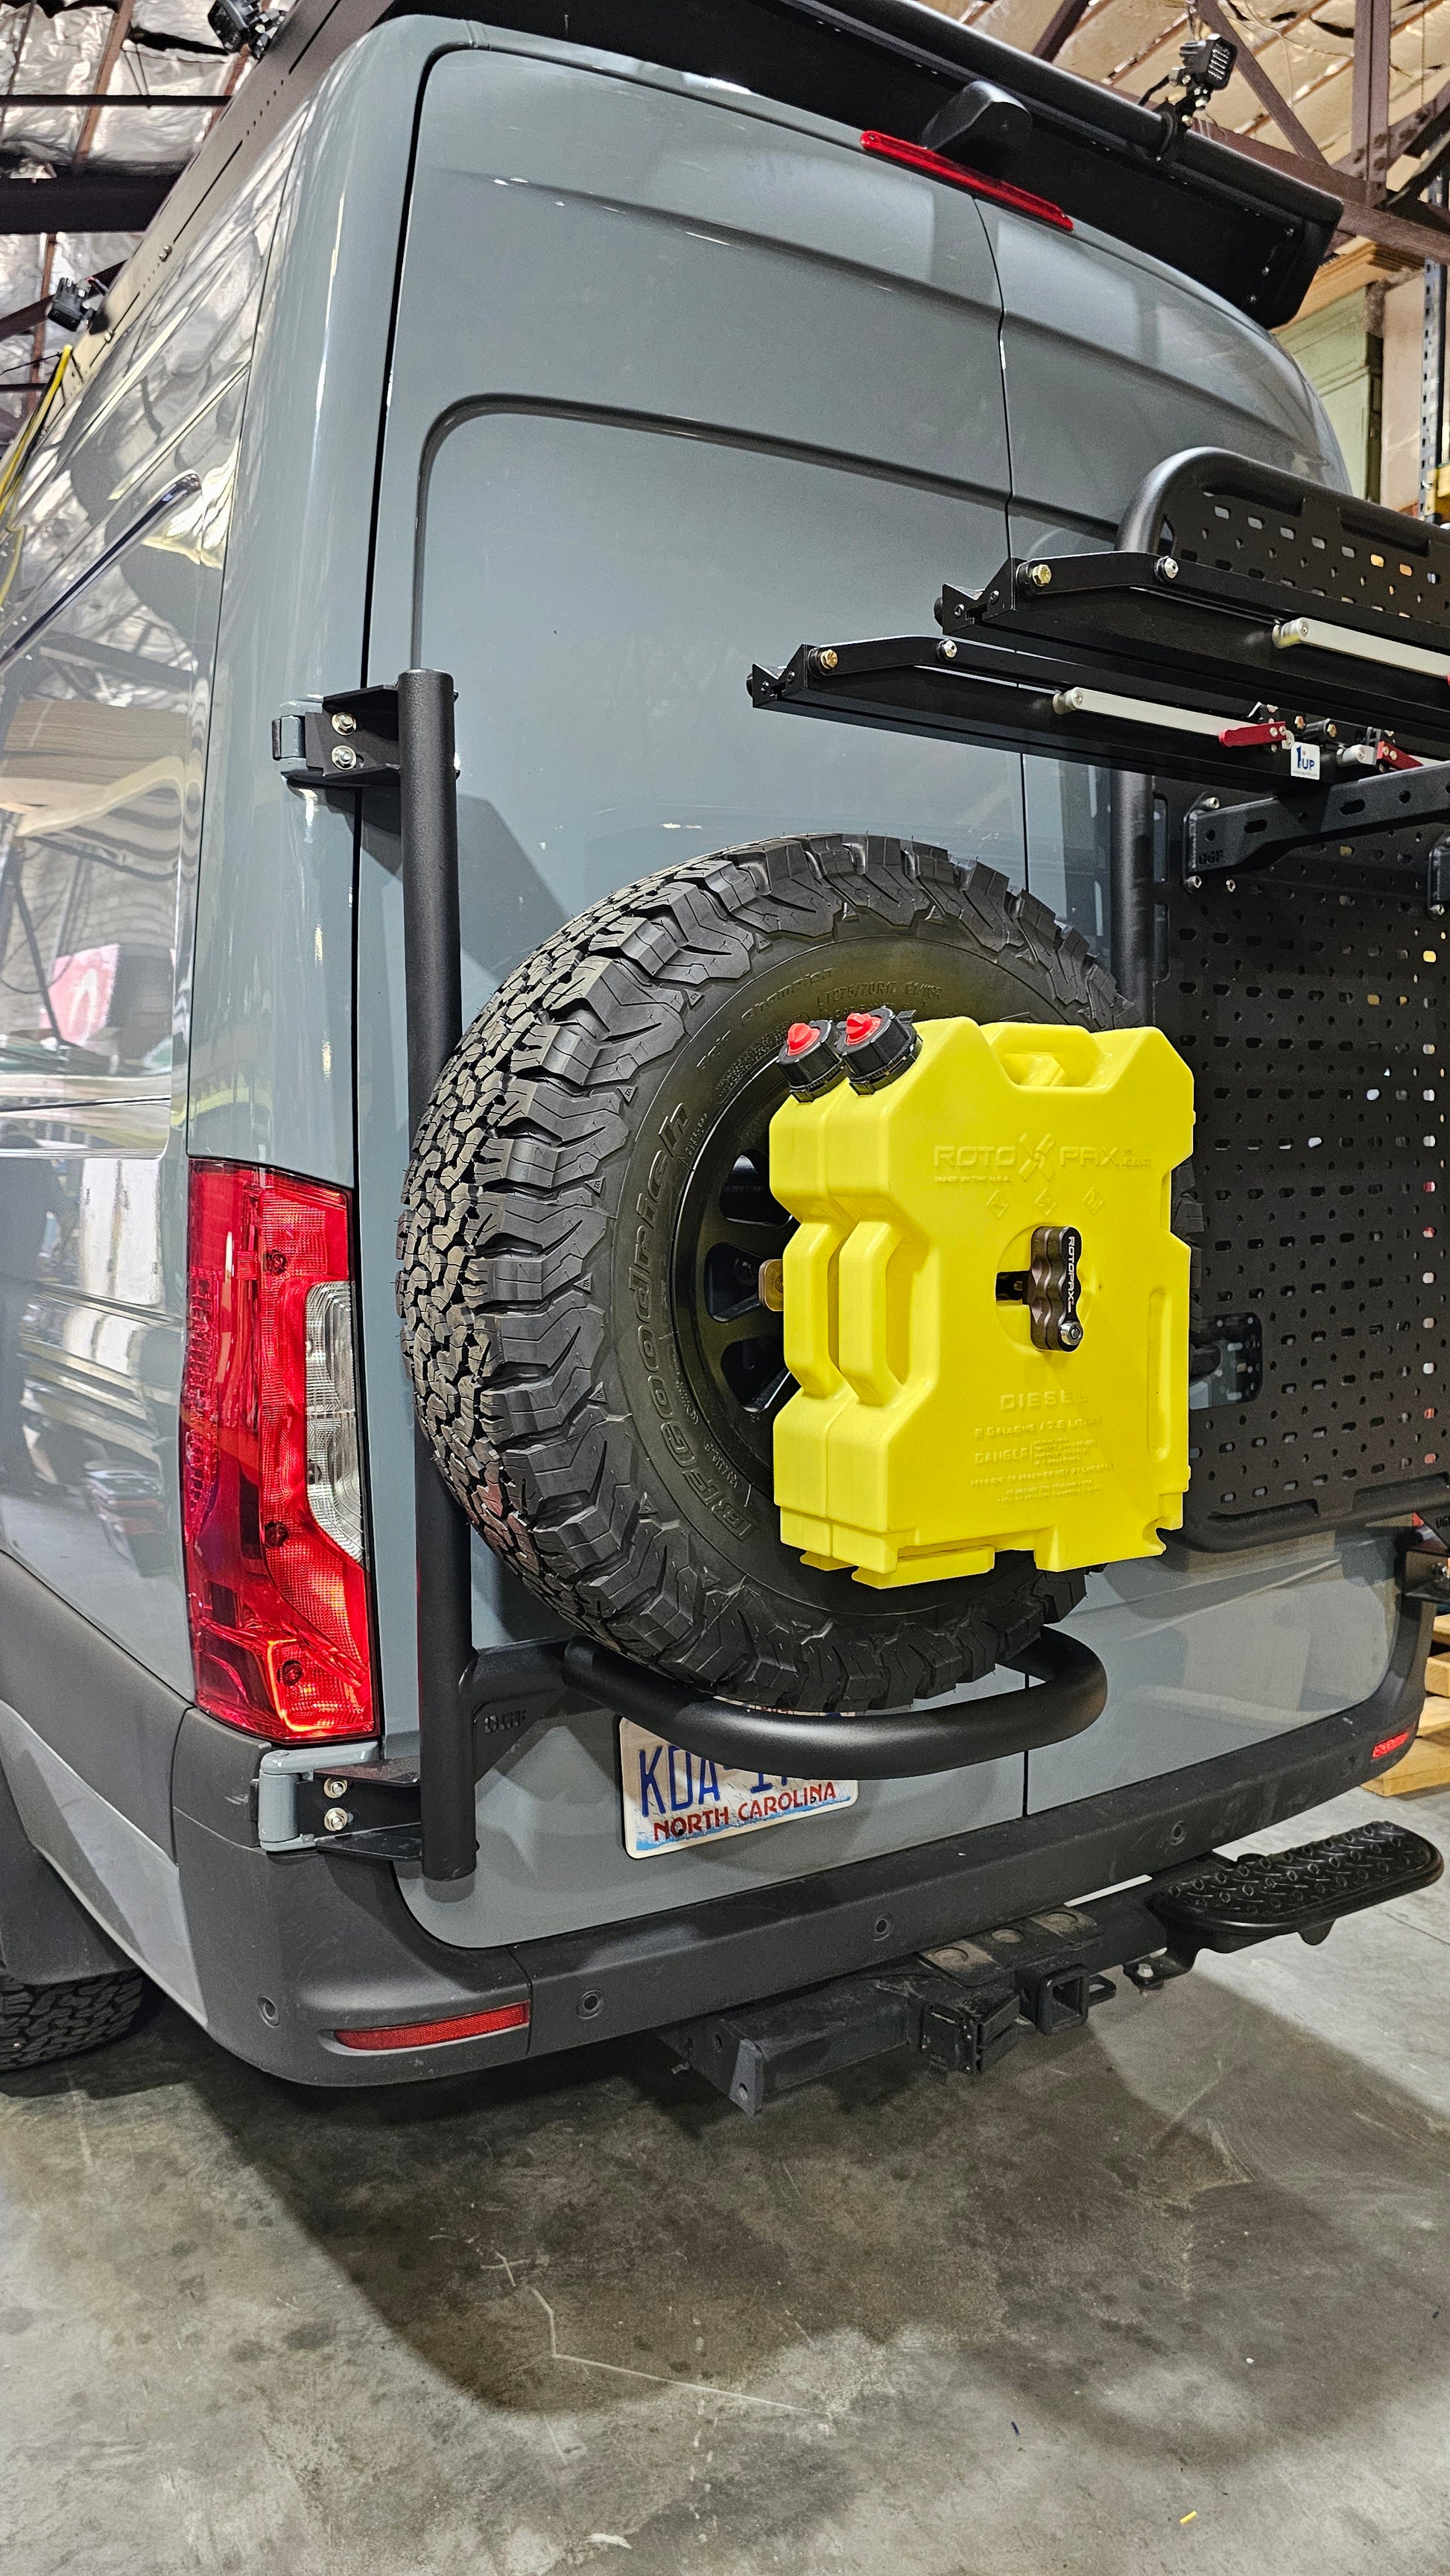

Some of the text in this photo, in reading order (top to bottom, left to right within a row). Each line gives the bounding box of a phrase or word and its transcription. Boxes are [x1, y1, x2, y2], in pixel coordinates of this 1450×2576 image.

[1000, 1389, 1089, 1410] DIESEL
[975, 1447, 1028, 1464] DANGER
[653, 1781, 837, 1841] NORTH CAROLINA
